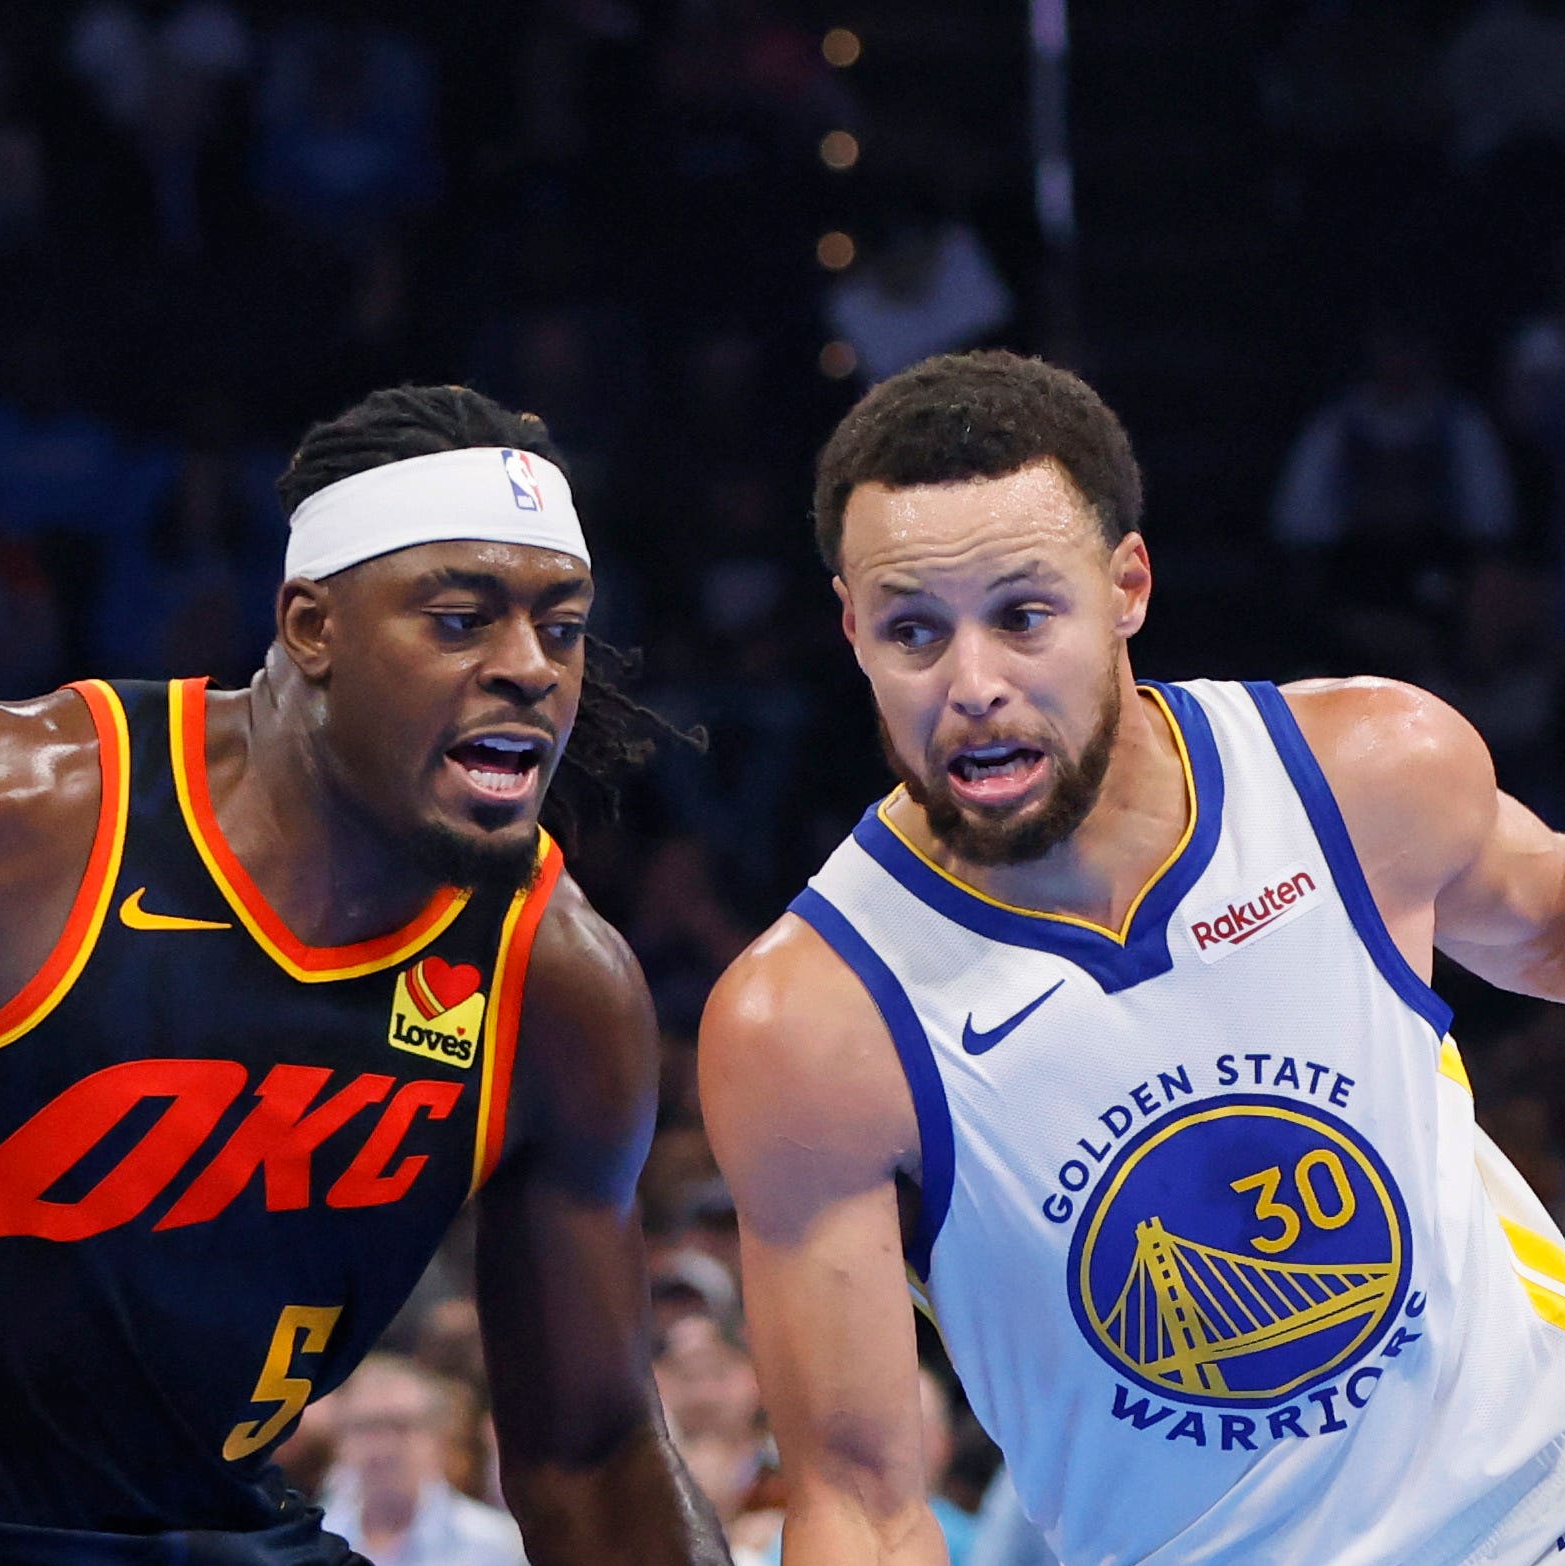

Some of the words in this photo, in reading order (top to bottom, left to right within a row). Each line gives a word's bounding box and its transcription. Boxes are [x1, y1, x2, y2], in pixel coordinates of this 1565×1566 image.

[1191, 871, 1317, 951] Rakuten
[1041, 1064, 1193, 1225] GOLDEN
[1217, 1053, 1356, 1107] STATE
[1229, 1148, 1356, 1254] 30
[222, 1305, 342, 1462] 5
